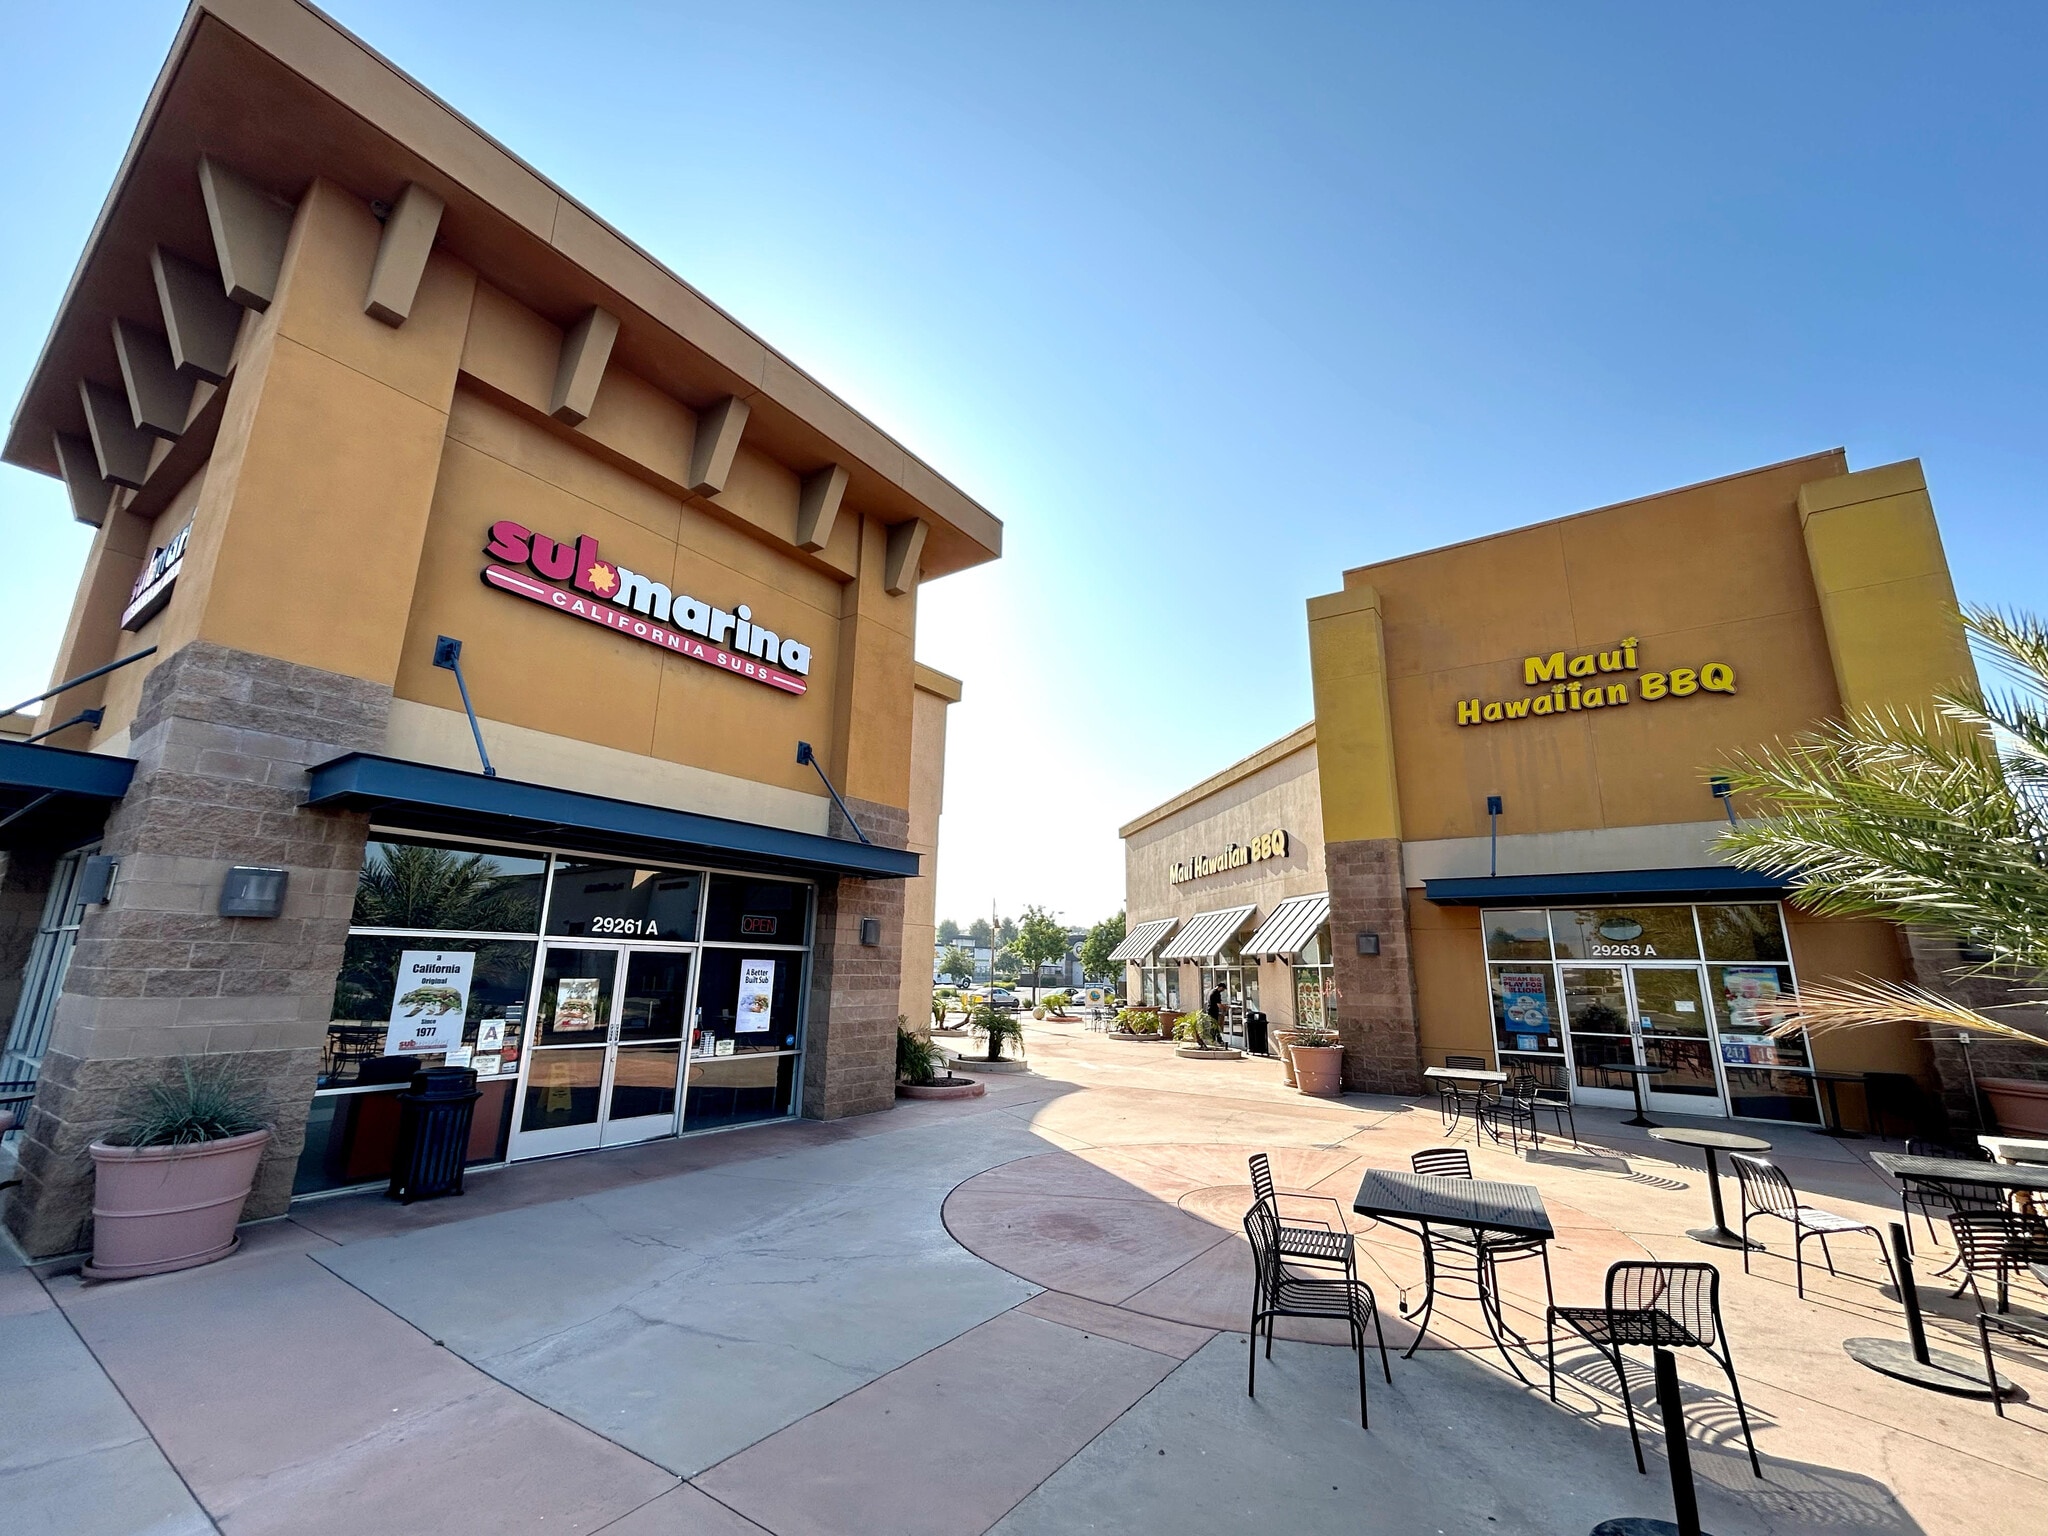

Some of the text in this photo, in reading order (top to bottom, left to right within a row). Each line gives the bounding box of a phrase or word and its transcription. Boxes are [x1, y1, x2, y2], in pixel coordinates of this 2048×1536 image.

[484, 520, 811, 676] submarina
[551, 591, 768, 681] CALIFORNIA SUBS
[1523, 636, 1639, 686] Maui
[1456, 661, 1738, 726] Hawaiian BBQ
[1169, 828, 1288, 885] Maui Hawaiian BBQ
[592, 917, 659, 936] 29261 A
[743, 917, 775, 933] OPEN
[1592, 944, 1657, 956] 29263 A
[412, 964, 460, 974] California
[745, 968, 769, 976] A Better
[421, 977, 448, 985] Original
[745, 976, 769, 984] Built Sub
[416, 1027, 436, 1037] 1977
[483, 1026, 498, 1041] A
